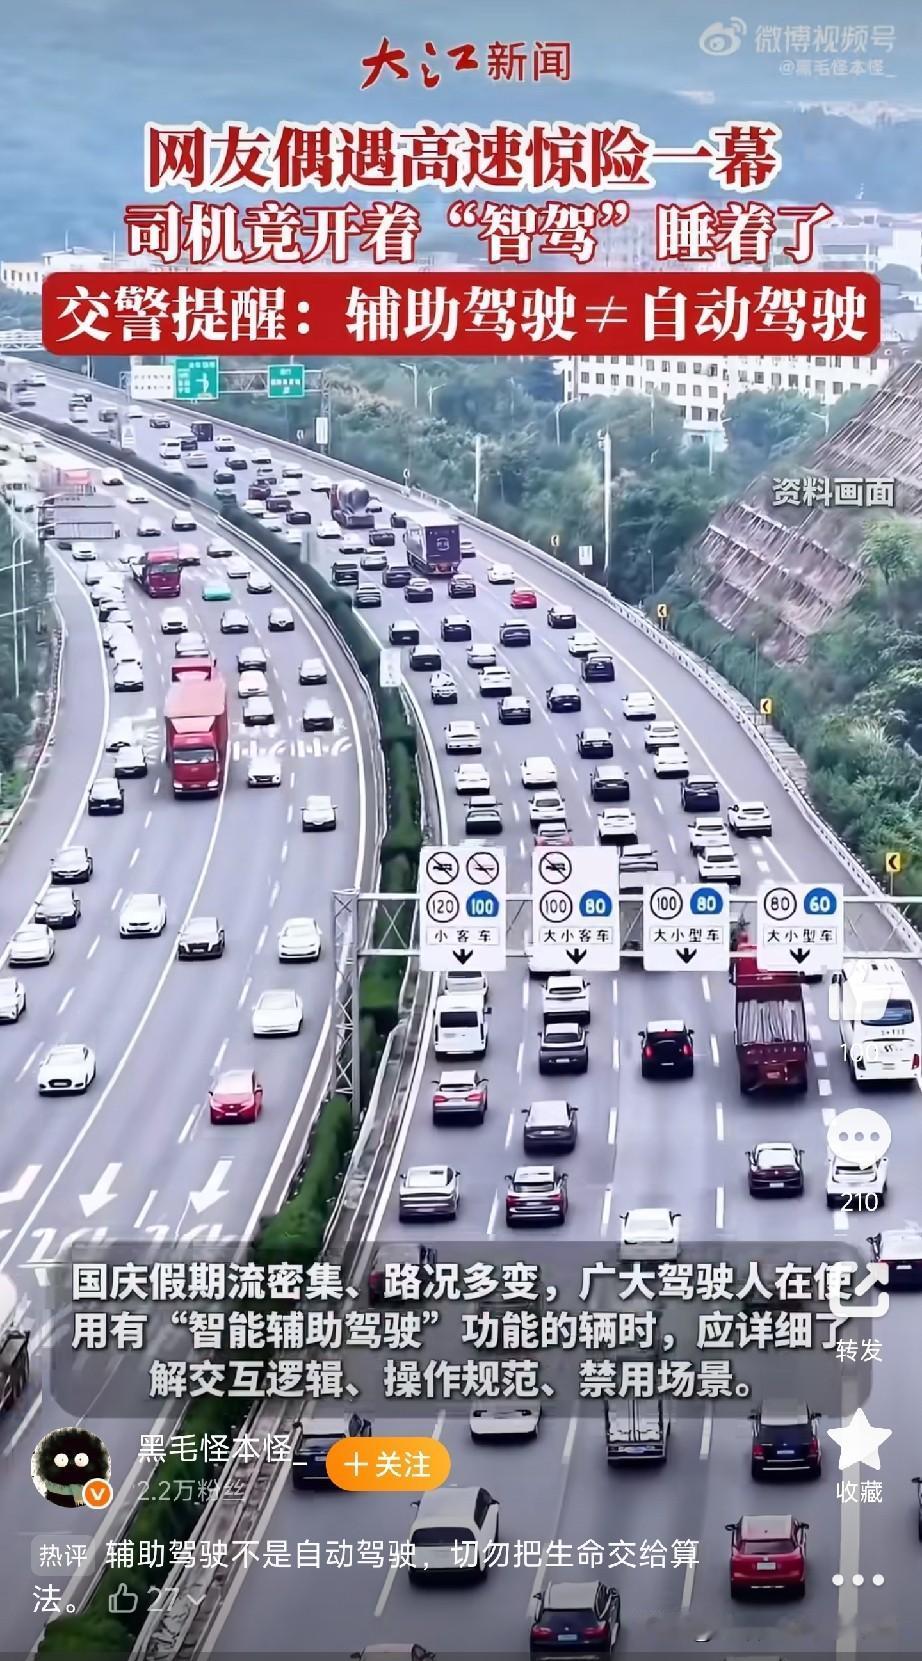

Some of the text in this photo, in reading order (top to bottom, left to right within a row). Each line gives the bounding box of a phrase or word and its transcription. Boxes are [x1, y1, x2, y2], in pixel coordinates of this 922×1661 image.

[432, 899, 494, 915] 120 100
[545, 899, 606, 915] 100 80
[657, 895, 716, 912] 100 80
[770, 895, 829, 912] 80 60
[434, 929, 492, 943] 小客车
[543, 929, 610, 944] 大小客车
[653, 928, 720, 943] 大小型车
[767, 928, 833, 943] 大小型车
